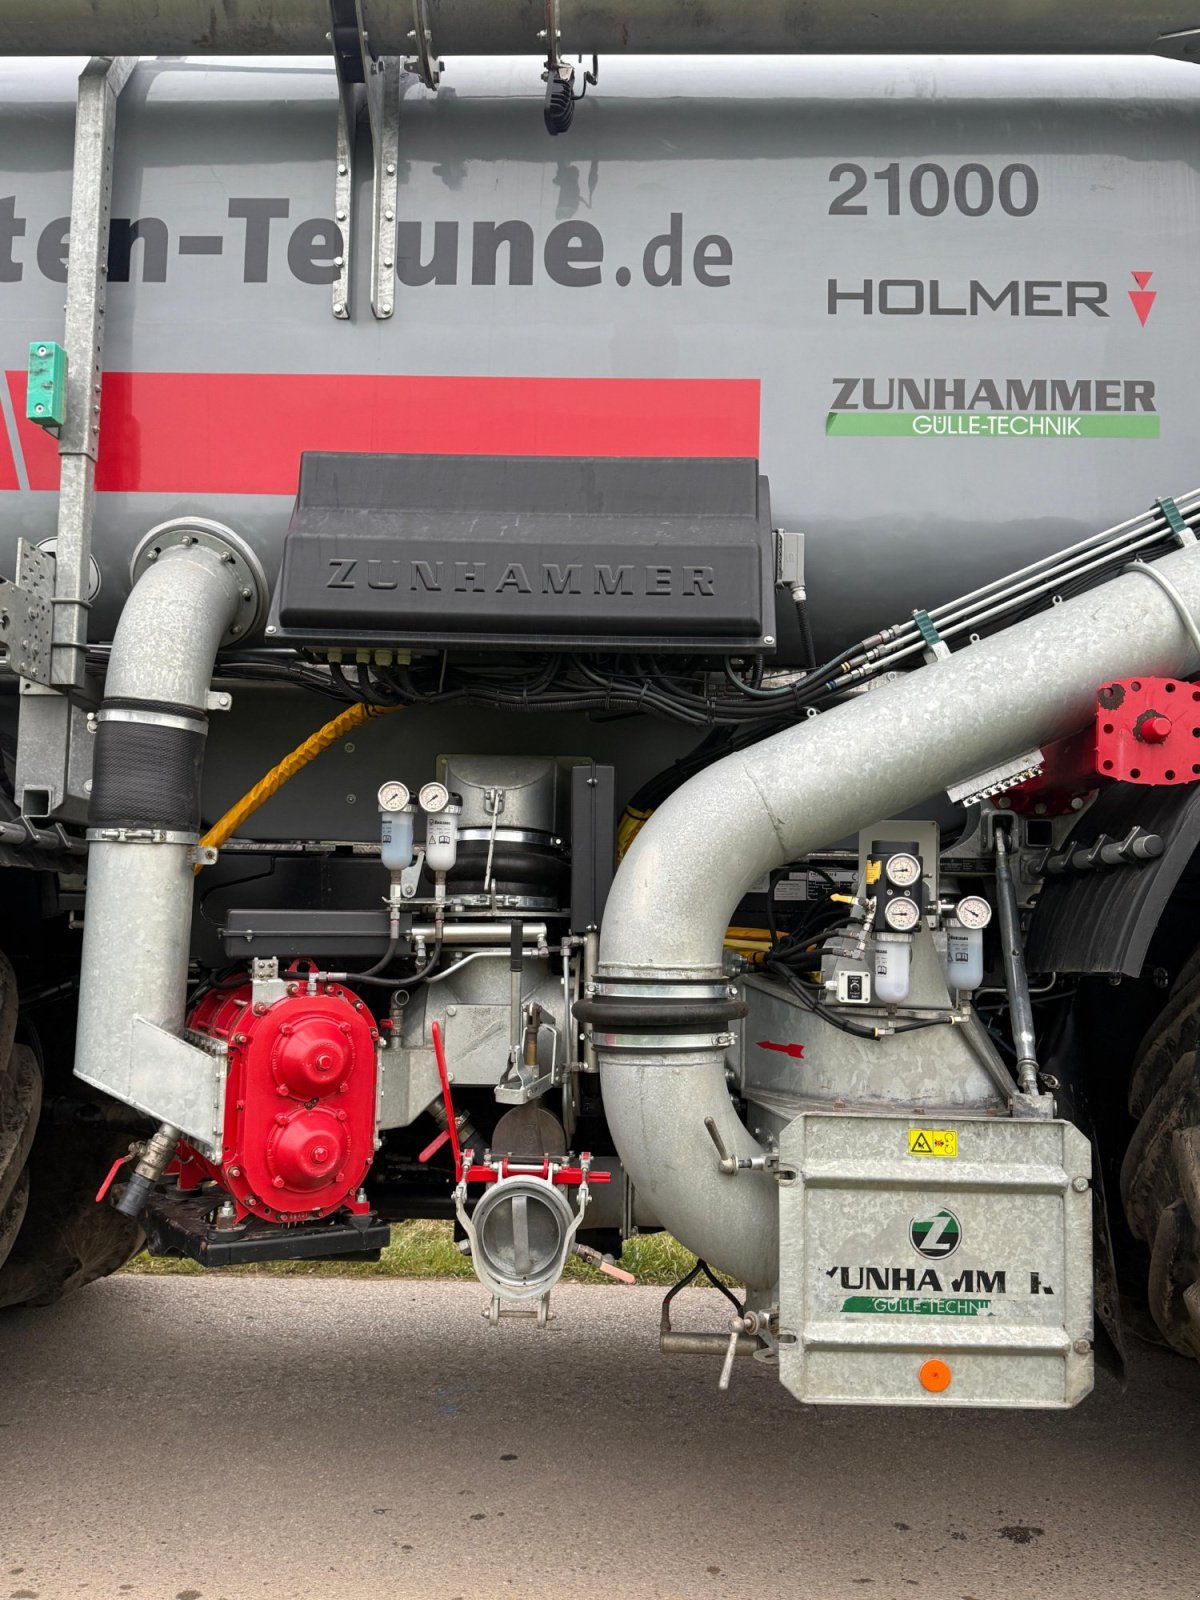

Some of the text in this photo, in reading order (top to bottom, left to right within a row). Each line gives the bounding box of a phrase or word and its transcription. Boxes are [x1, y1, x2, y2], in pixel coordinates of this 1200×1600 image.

[828, 162, 1039, 217] 21000
[827, 278, 1111, 317] HOLMER
[830, 377, 1157, 412] ZUNHAMMER
[912, 415, 1082, 436] GÜLLE-TECHNIK
[326, 557, 716, 597] ZUNHAMMER
